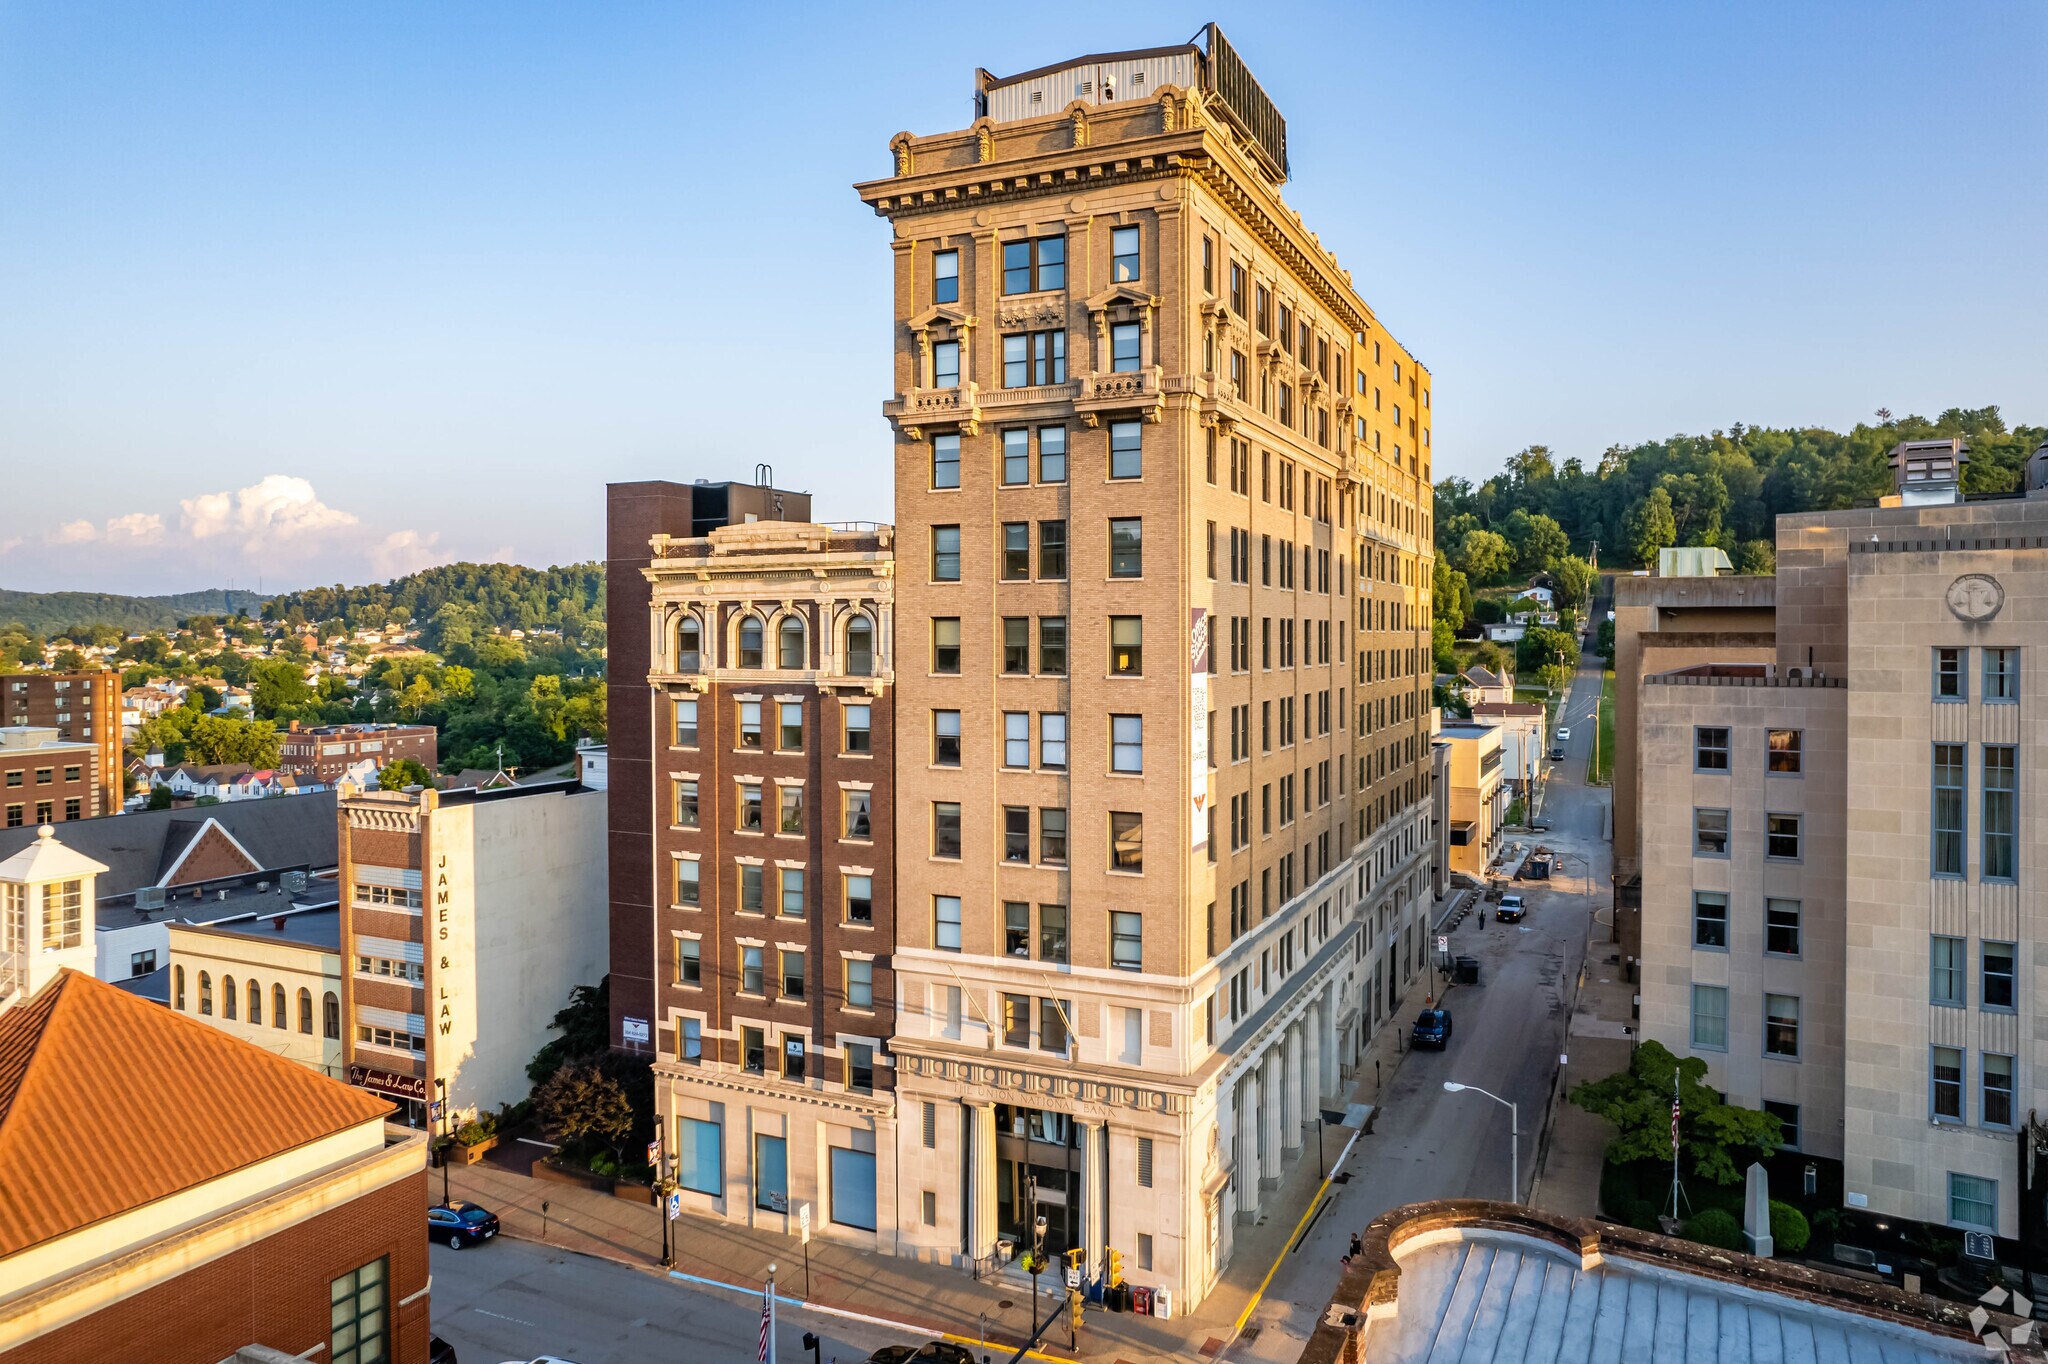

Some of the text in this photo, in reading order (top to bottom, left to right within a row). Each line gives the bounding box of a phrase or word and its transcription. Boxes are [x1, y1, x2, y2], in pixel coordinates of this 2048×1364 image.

[438, 855, 452, 1036] JAMES & LAW
[351, 1066, 426, 1094] The James & Law Co.
[954, 1082, 1117, 1118] THE UNION NATIONAL BANK
